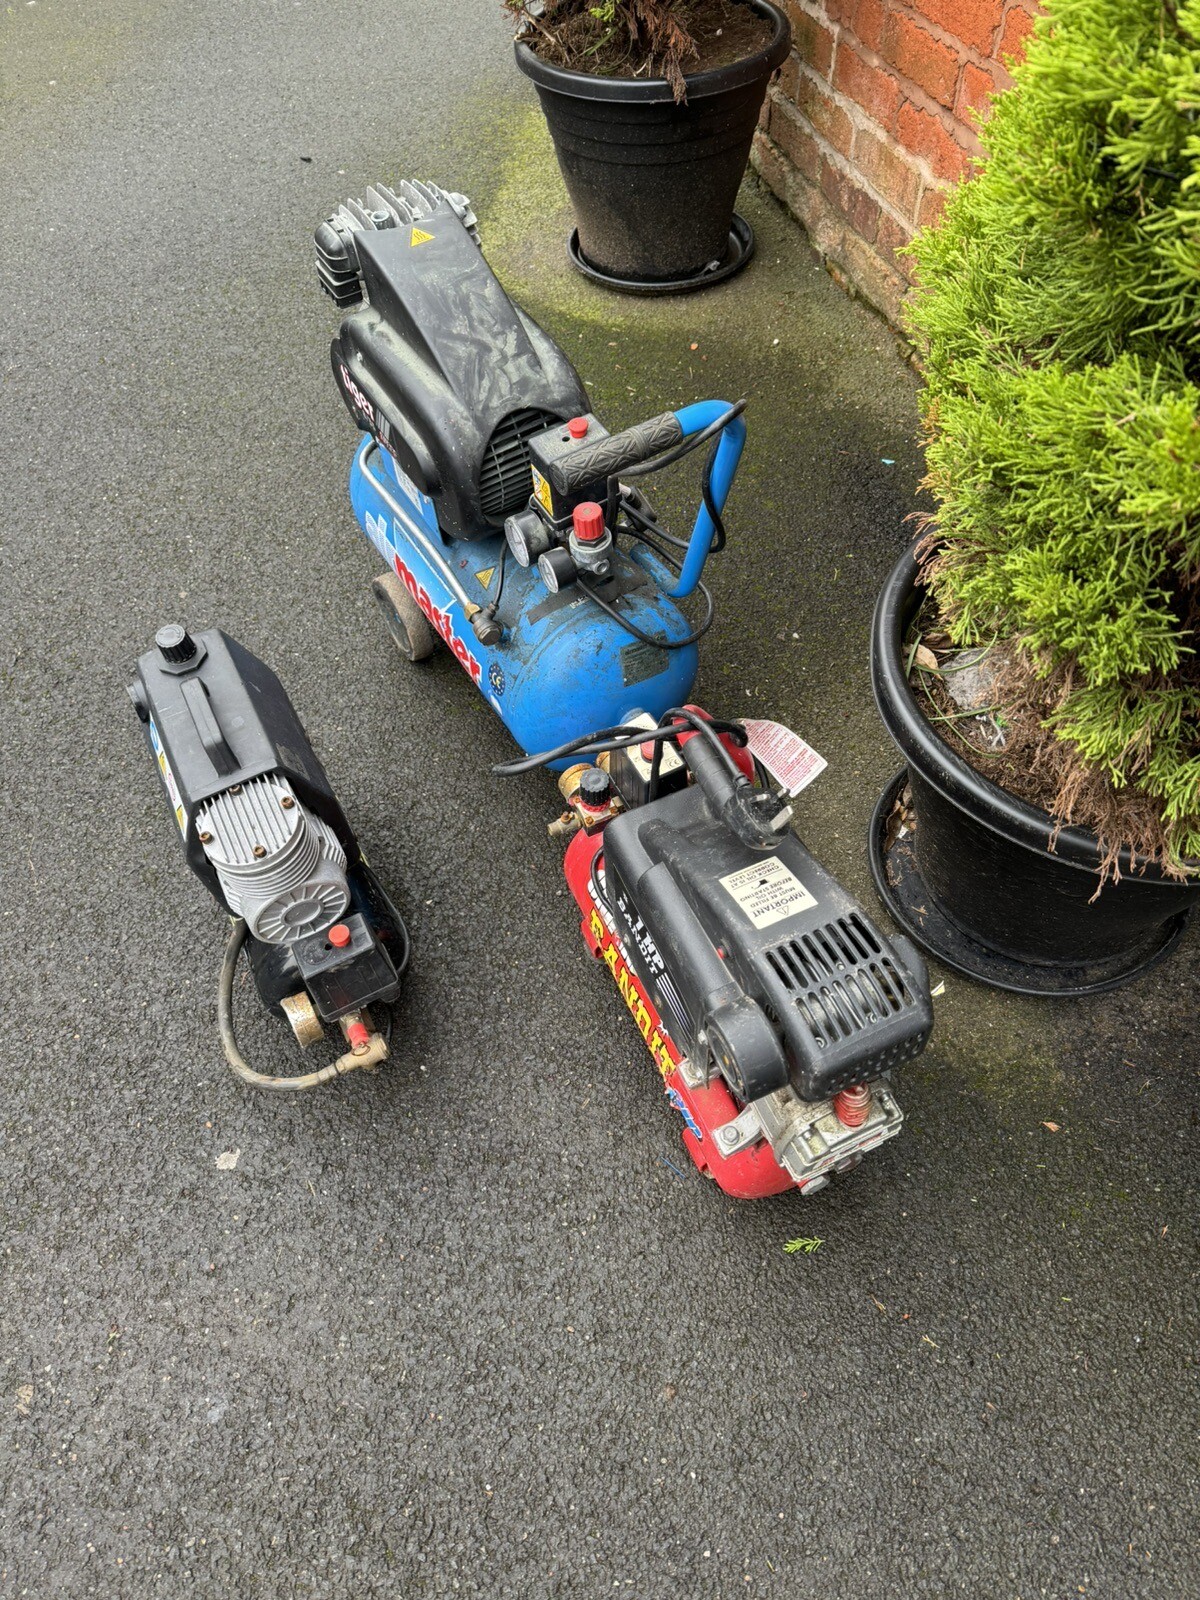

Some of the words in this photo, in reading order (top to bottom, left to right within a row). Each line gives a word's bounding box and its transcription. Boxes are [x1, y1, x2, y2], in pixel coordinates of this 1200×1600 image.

[341, 364, 375, 421] tiger
[757, 864, 779, 876] CHECK
[768, 876, 792, 889] BEFORE
[766, 886, 783, 895] WITH
[778, 886, 795, 896] MUST
[751, 890, 806, 917] IMPORTANT
[617, 896, 659, 975] BANDIT
